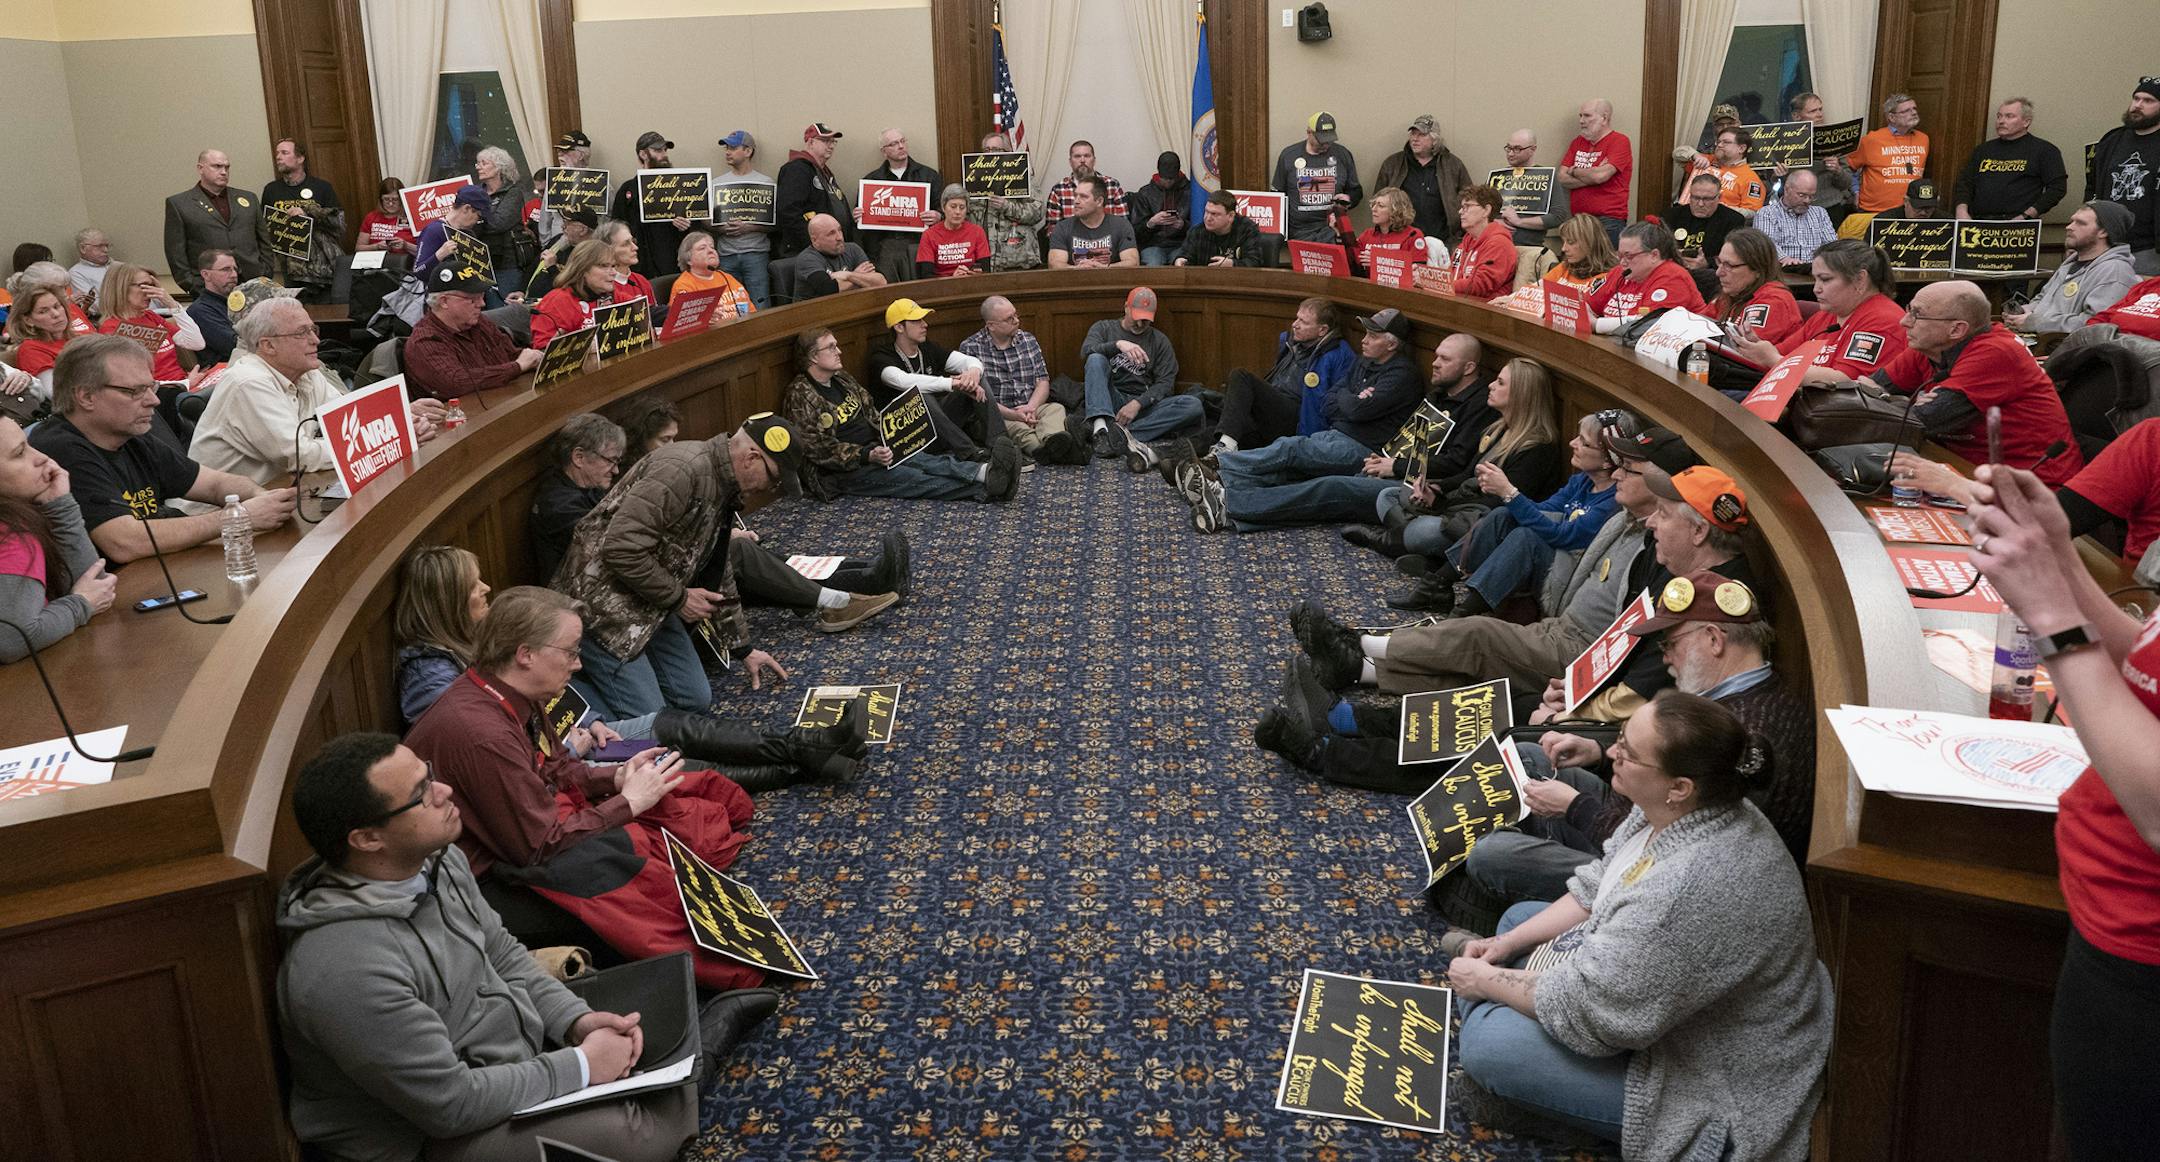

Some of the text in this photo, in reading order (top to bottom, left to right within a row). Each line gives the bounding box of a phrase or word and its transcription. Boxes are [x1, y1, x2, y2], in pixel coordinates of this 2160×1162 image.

[1782, 124, 1808, 137] not
[1815, 129, 1860, 145] CAUCUS
[1002, 155, 1026, 168] not
[1990, 164, 2026, 172] CAUCUS
[1297, 166, 1337, 177] DEFEND THE
[1881, 166, 1908, 177] GETTIN
[647, 175, 704, 189] Shall not
[1504, 181, 1548, 191] CAUCUS
[435, 194, 457, 208] NR
[643, 189, 655, 204] be
[731, 194, 773, 205] CAUCUS
[889, 195, 919, 208] NRA
[870, 206, 891, 216] STAND
[900, 208, 919, 218] FIGHT
[1246, 205, 1274, 217] NRA
[1880, 221, 1952, 237] Shall not
[2001, 228, 2036, 237] OWNERS
[1073, 235, 1111, 249] DEFEND THE
[1892, 236, 1954, 260] infringed
[1981, 236, 2035, 248] CAUCUS
[601, 307, 632, 331] Shall
[634, 301, 647, 323] not
[116, 322, 168, 342] PROTECT
[600, 331, 611, 354] be
[896, 401, 926, 431] CAUCUS
[360, 413, 400, 452] NRA
[350, 454, 377, 484] STAND
[379, 439, 403, 467] FIGHT
[1910, 558, 1950, 590] ACTION
[1455, 706, 1477, 753] CAUCUS
[1442, 775, 1472, 796] be
[1472, 761, 1513, 808] Shall
[683, 882, 729, 946] Shall
[729, 939, 769, 965] be
[1301, 976, 1326, 1035] #JoinTheFight
[1321, 982, 1398, 1121] be infringed
[1393, 998, 1444, 1122] Shall not
[1286, 1067, 1304, 1105] CAUCUS
